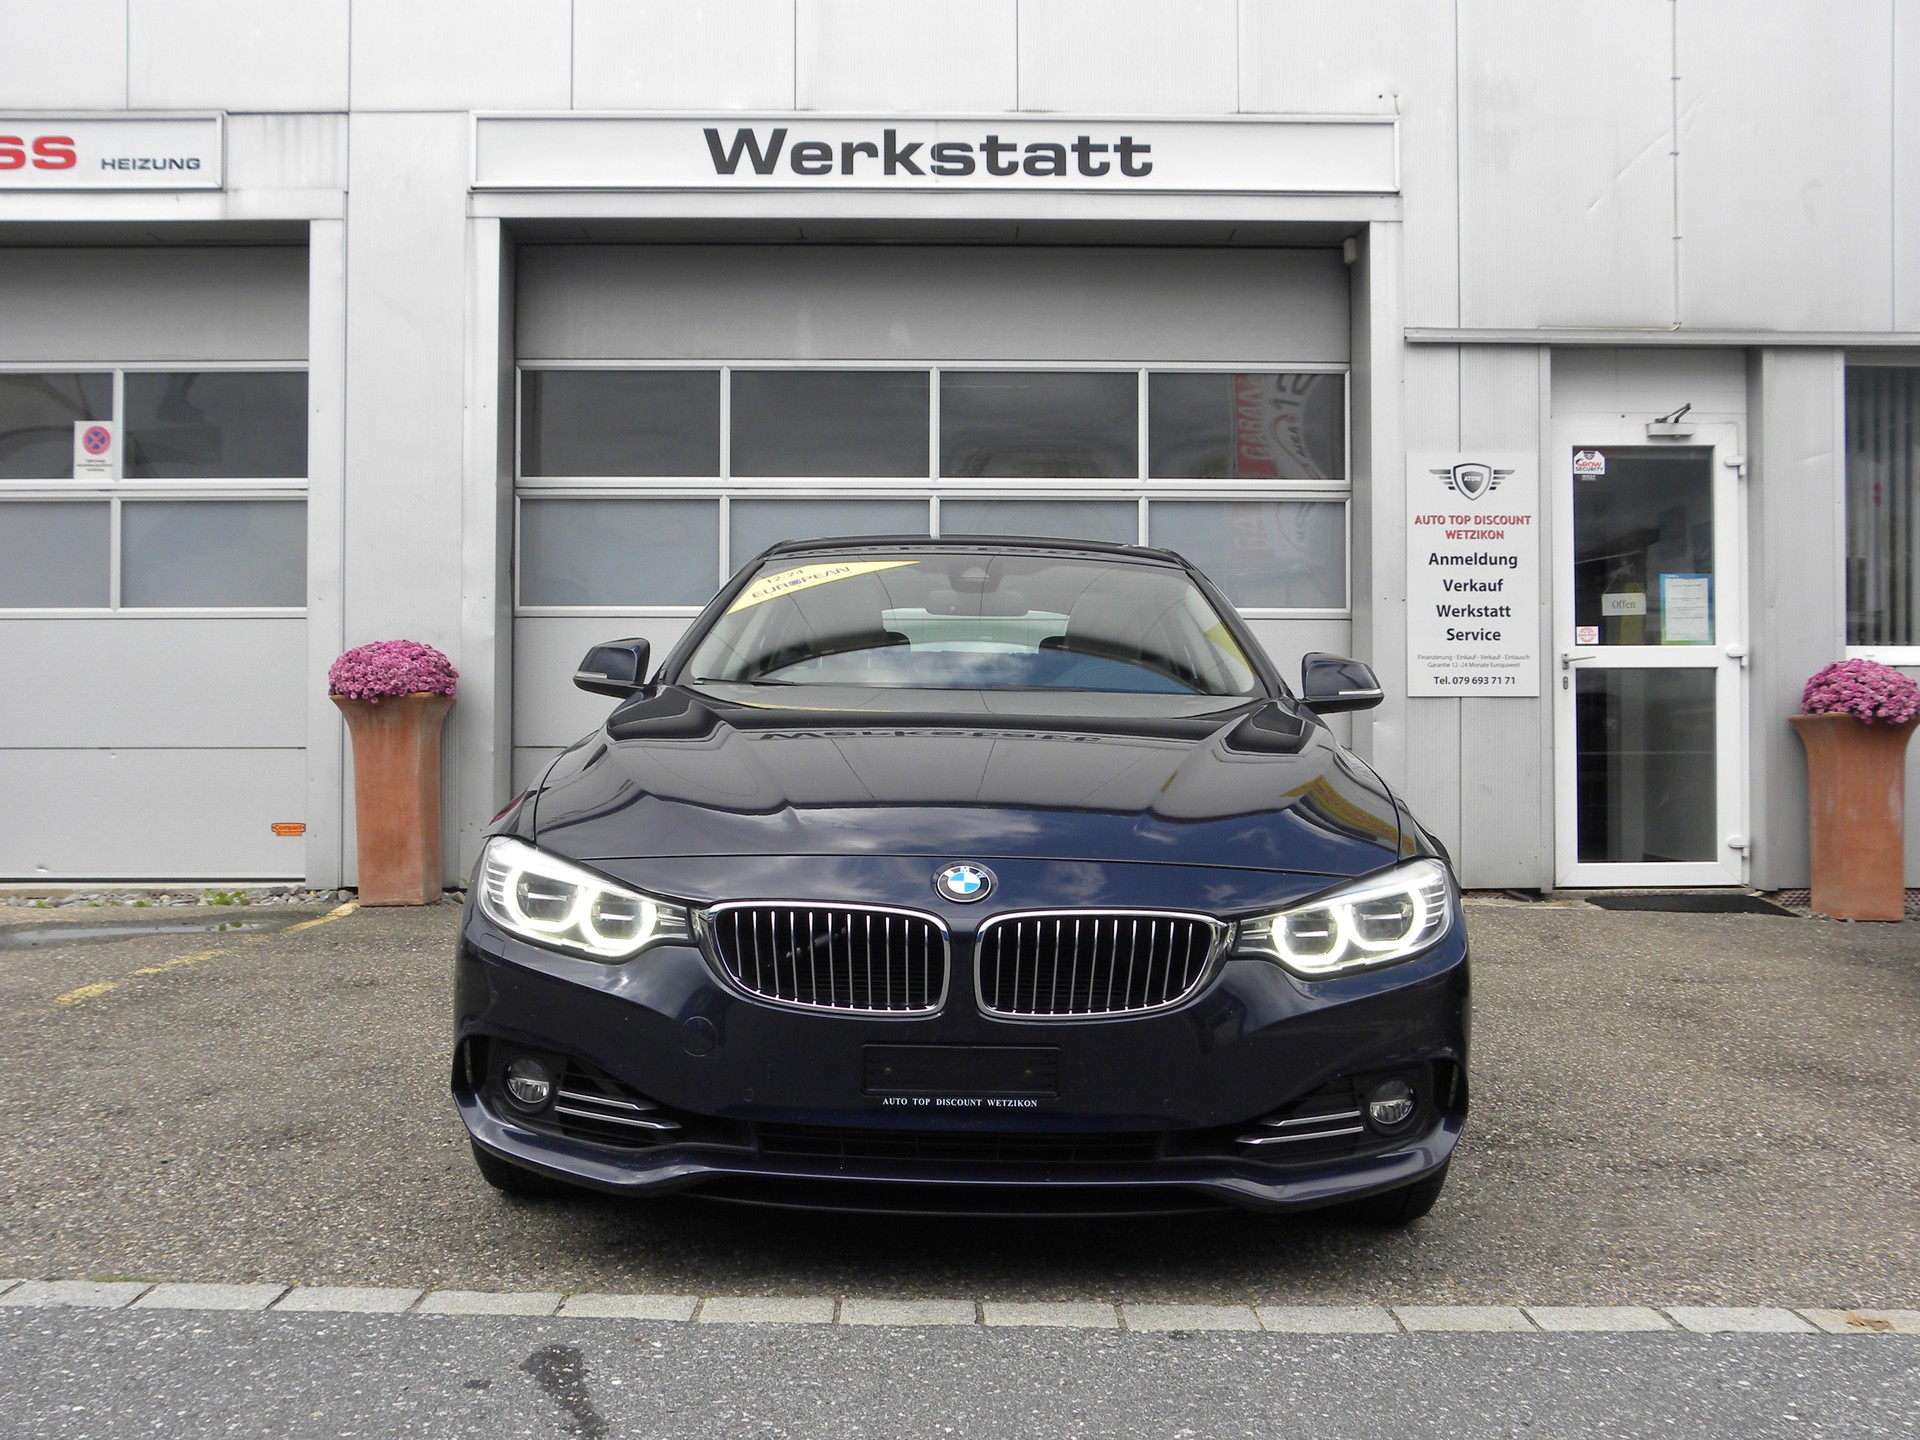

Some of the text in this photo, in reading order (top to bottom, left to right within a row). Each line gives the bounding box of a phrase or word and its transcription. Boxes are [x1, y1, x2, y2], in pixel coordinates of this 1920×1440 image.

[702, 127, 1154, 178] Werkstatt
[101, 157, 201, 171] HEIZUNG
[1414, 515, 1532, 525] AUTO TOP DISCOUNT
[1445, 530, 1505, 540] WETZIKON
[1428, 552, 1518, 569] Anmeldung
[1442, 578, 1504, 592] Verkauf
[1436, 604, 1511, 618] Werkstatt
[1612, 599, 1636, 609] Offen
[1446, 627, 1502, 641] Service
[1433, 676, 1516, 685] Tel. 079 693 71 71
[882, 1097, 1038, 1108] AUTO TOP DISCOUNT WETZIKON
